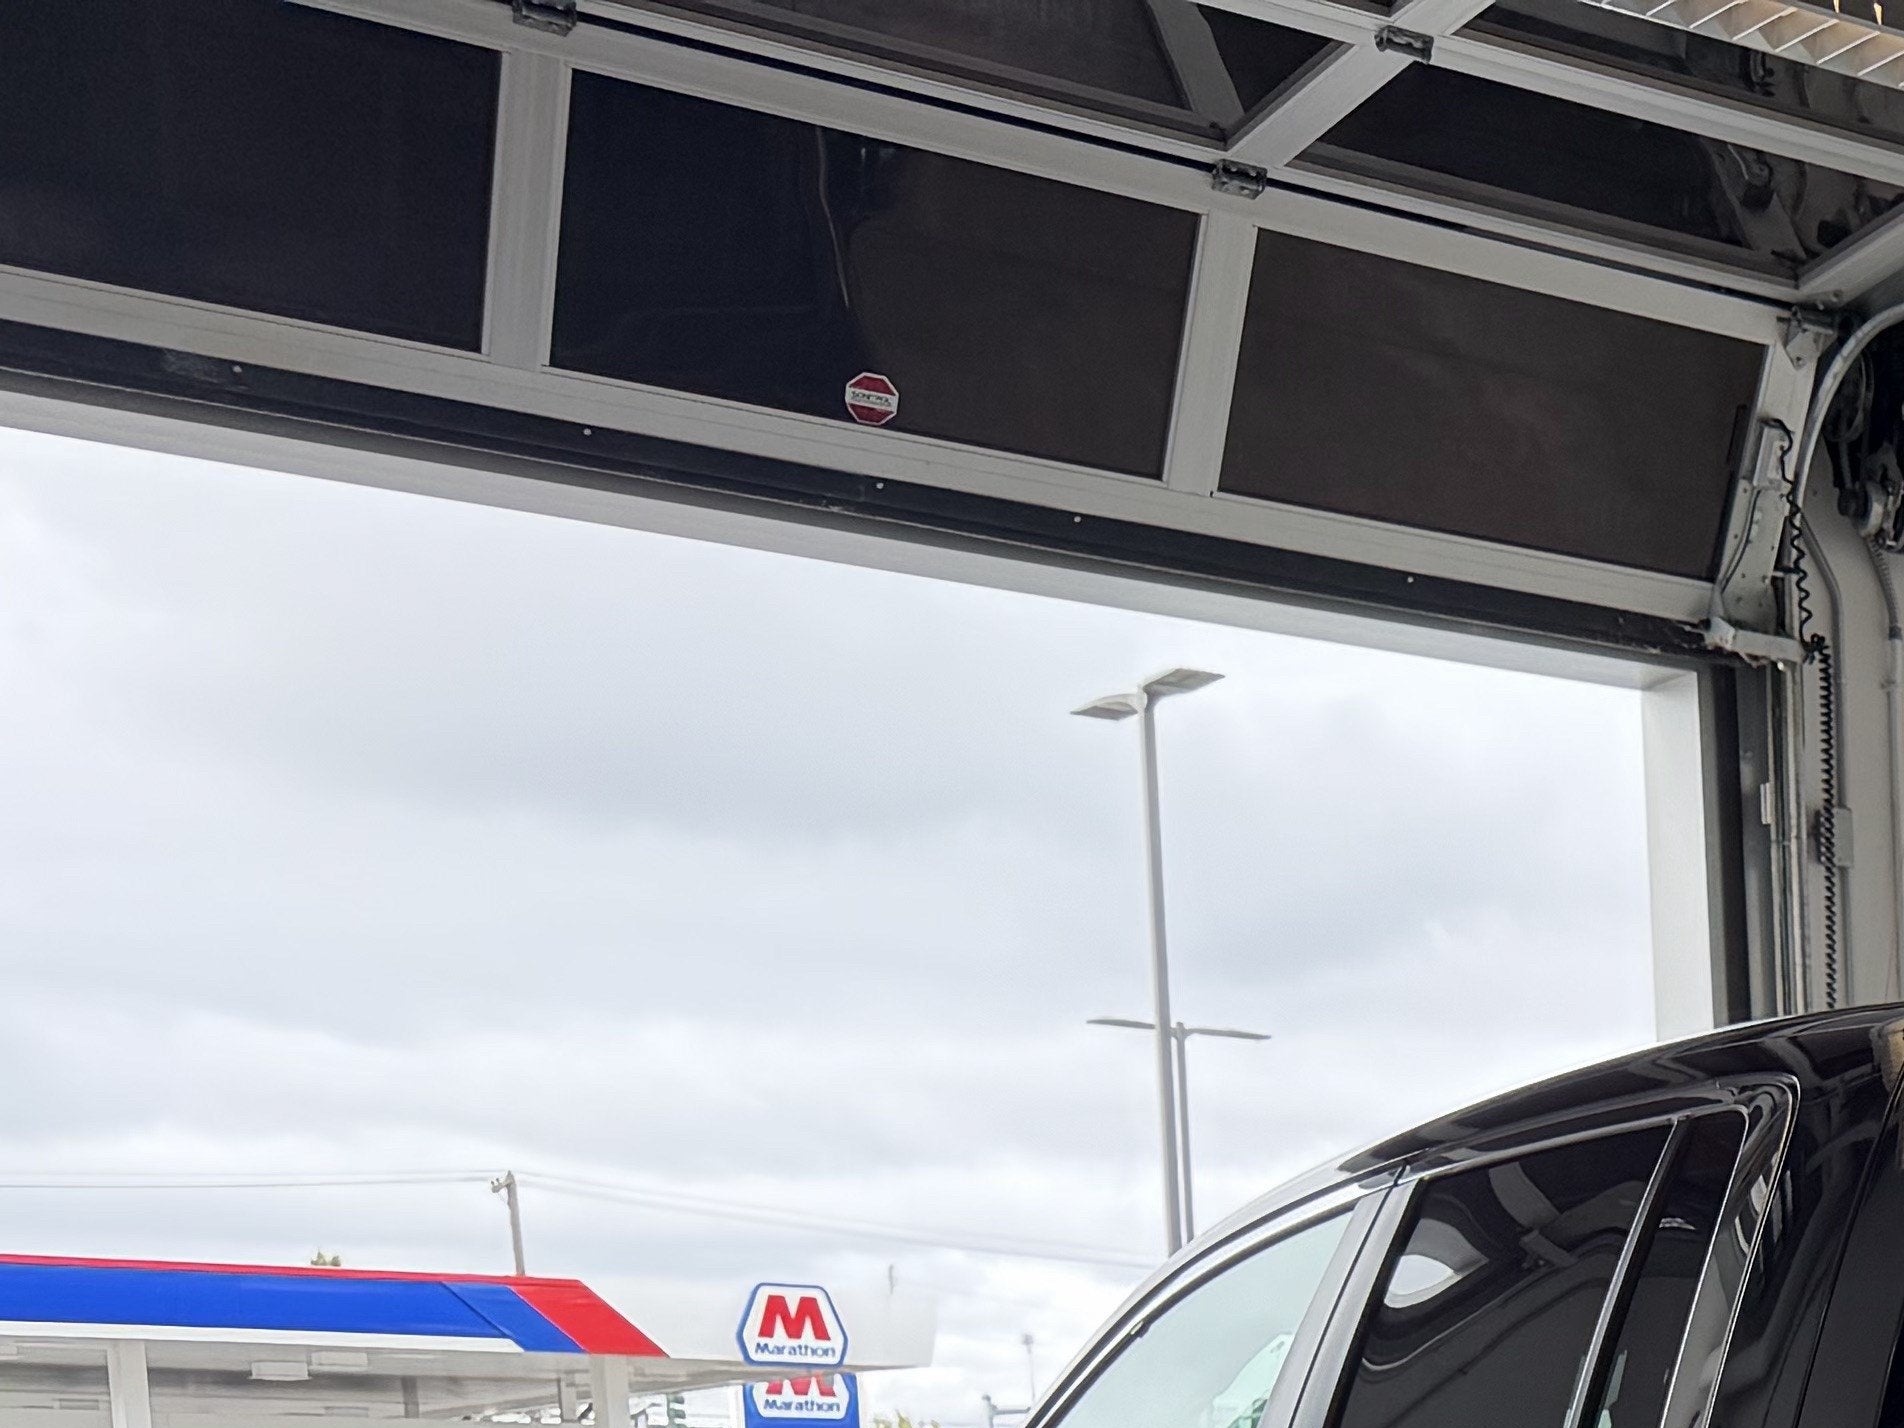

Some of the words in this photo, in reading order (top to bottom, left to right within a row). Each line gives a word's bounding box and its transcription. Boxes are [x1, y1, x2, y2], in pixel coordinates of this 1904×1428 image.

[758, 1295, 831, 1340] M
[754, 1342, 836, 1358] Marathon
[763, 1398, 841, 1413] Marathon
